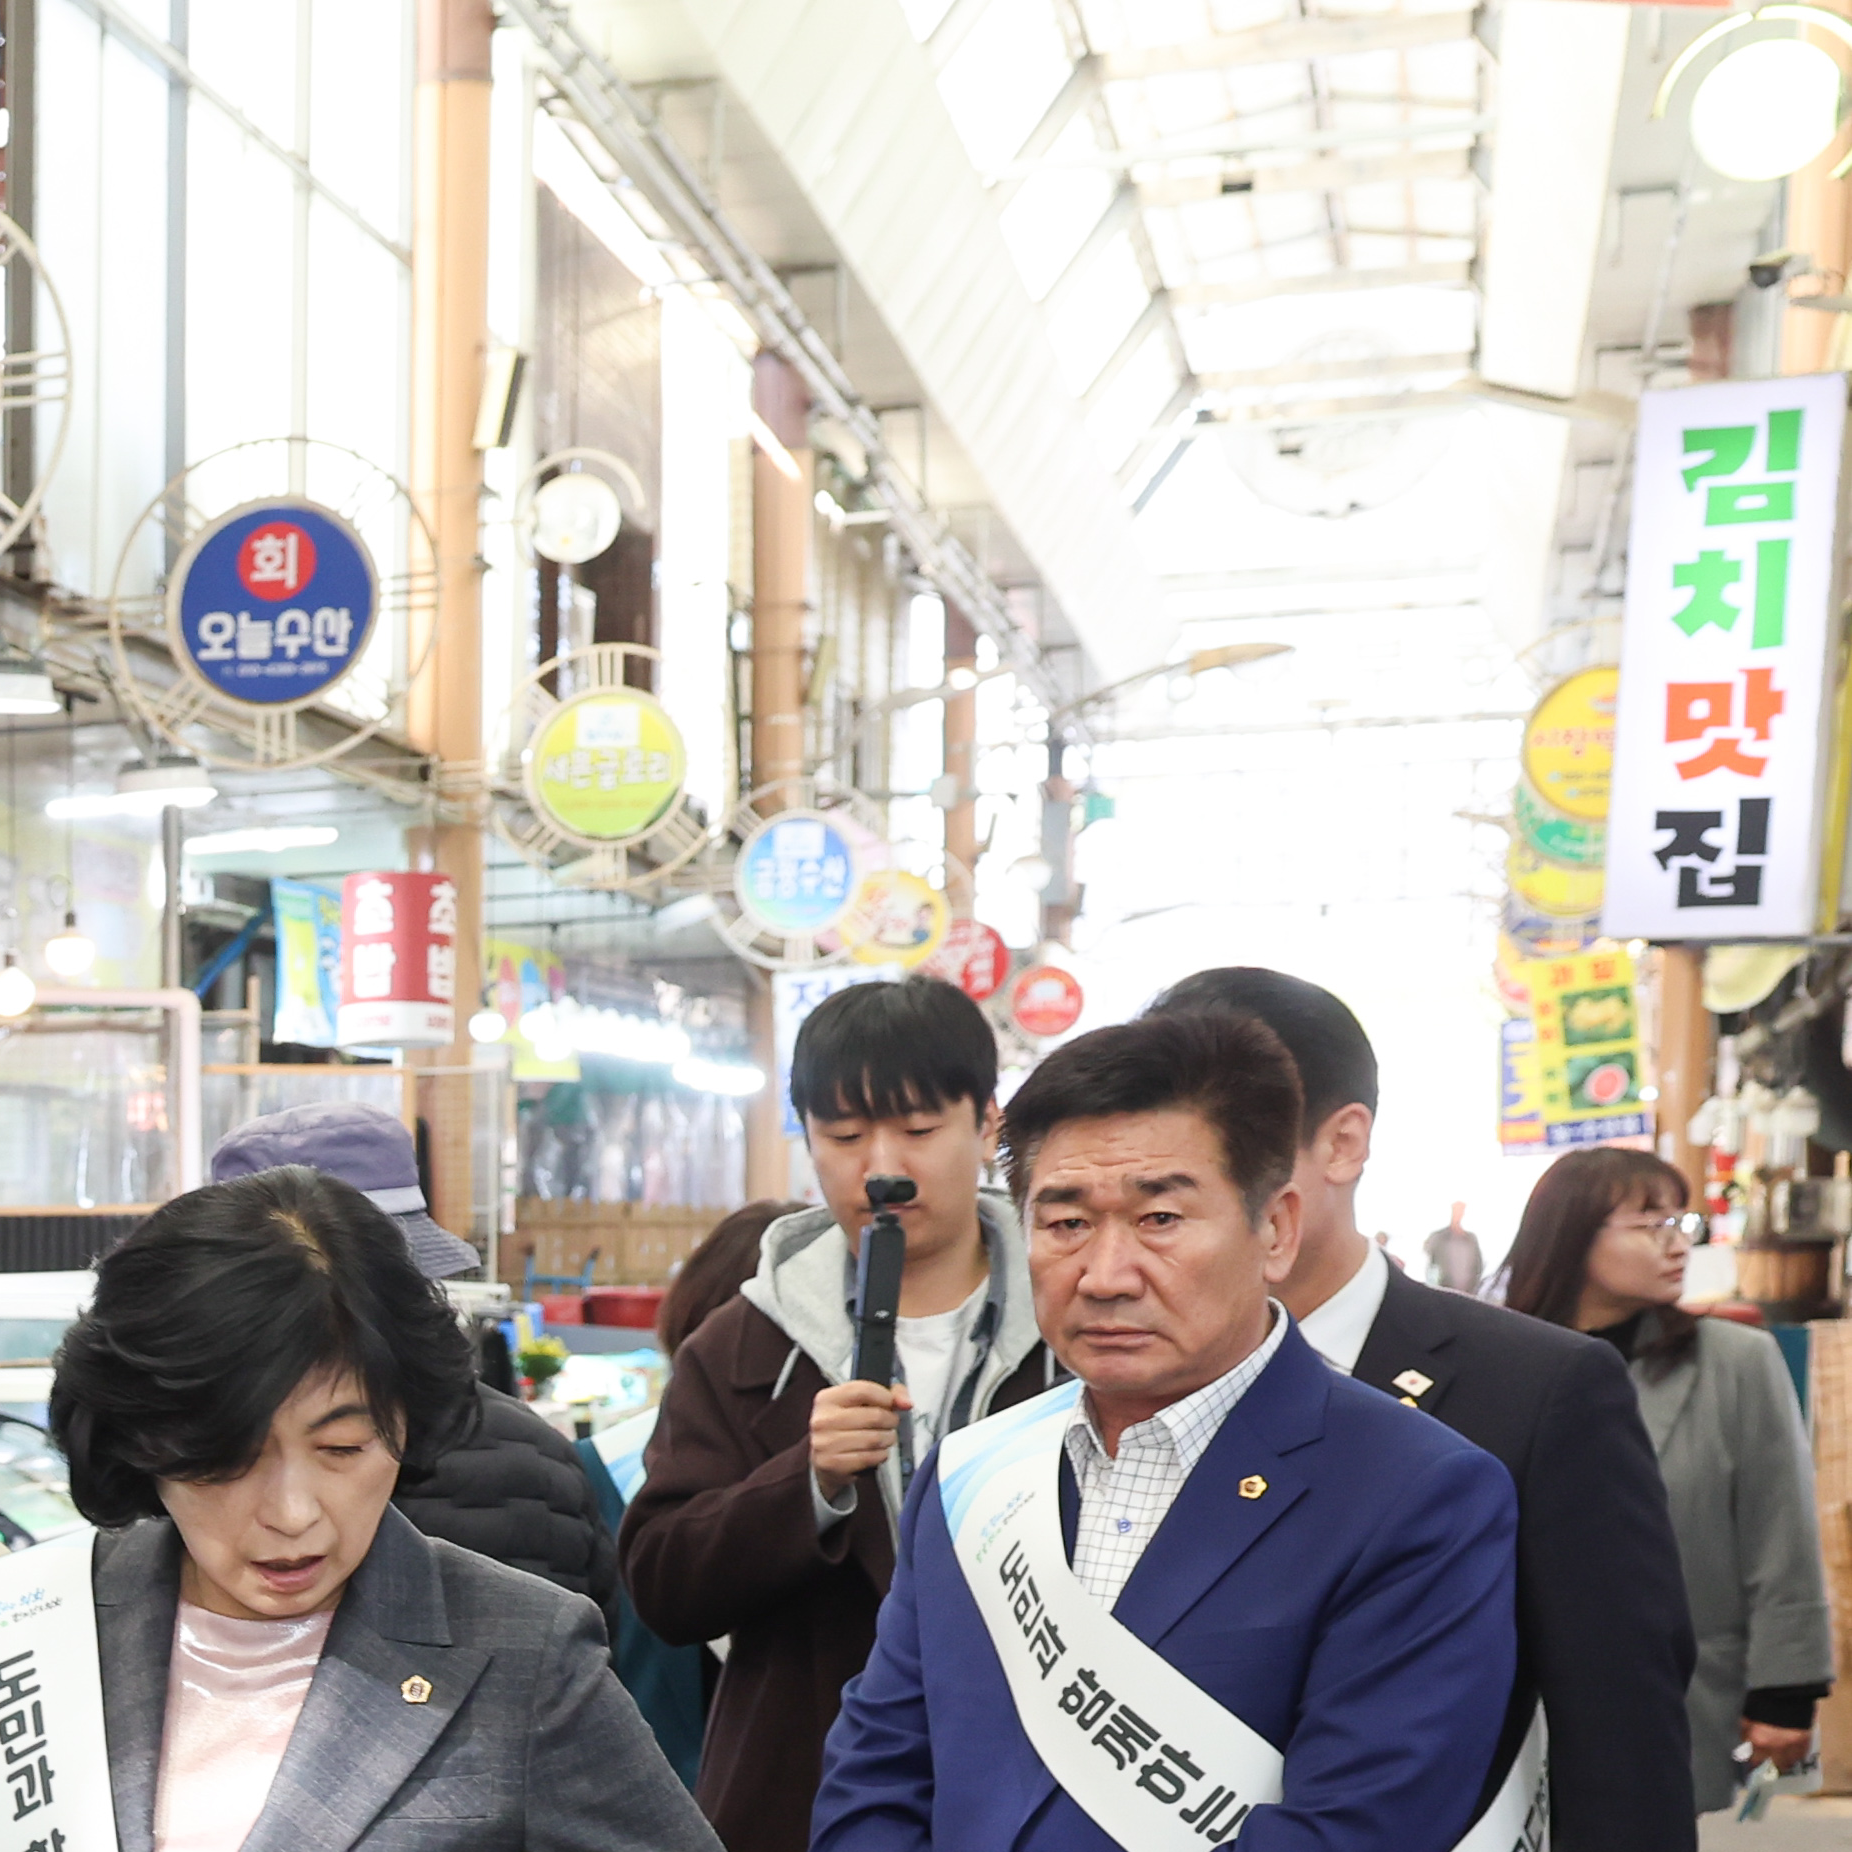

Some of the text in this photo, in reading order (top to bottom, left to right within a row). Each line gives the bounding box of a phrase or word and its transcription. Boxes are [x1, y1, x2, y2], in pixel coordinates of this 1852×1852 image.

[197, 606, 354, 662] 오늘수산
[251, 533, 299, 590] 회
[1653, 407, 1805, 909] 김치맛집
[999, 1539, 1068, 1681] 도민과
[1057, 1666, 1251, 1844] 함께하는
